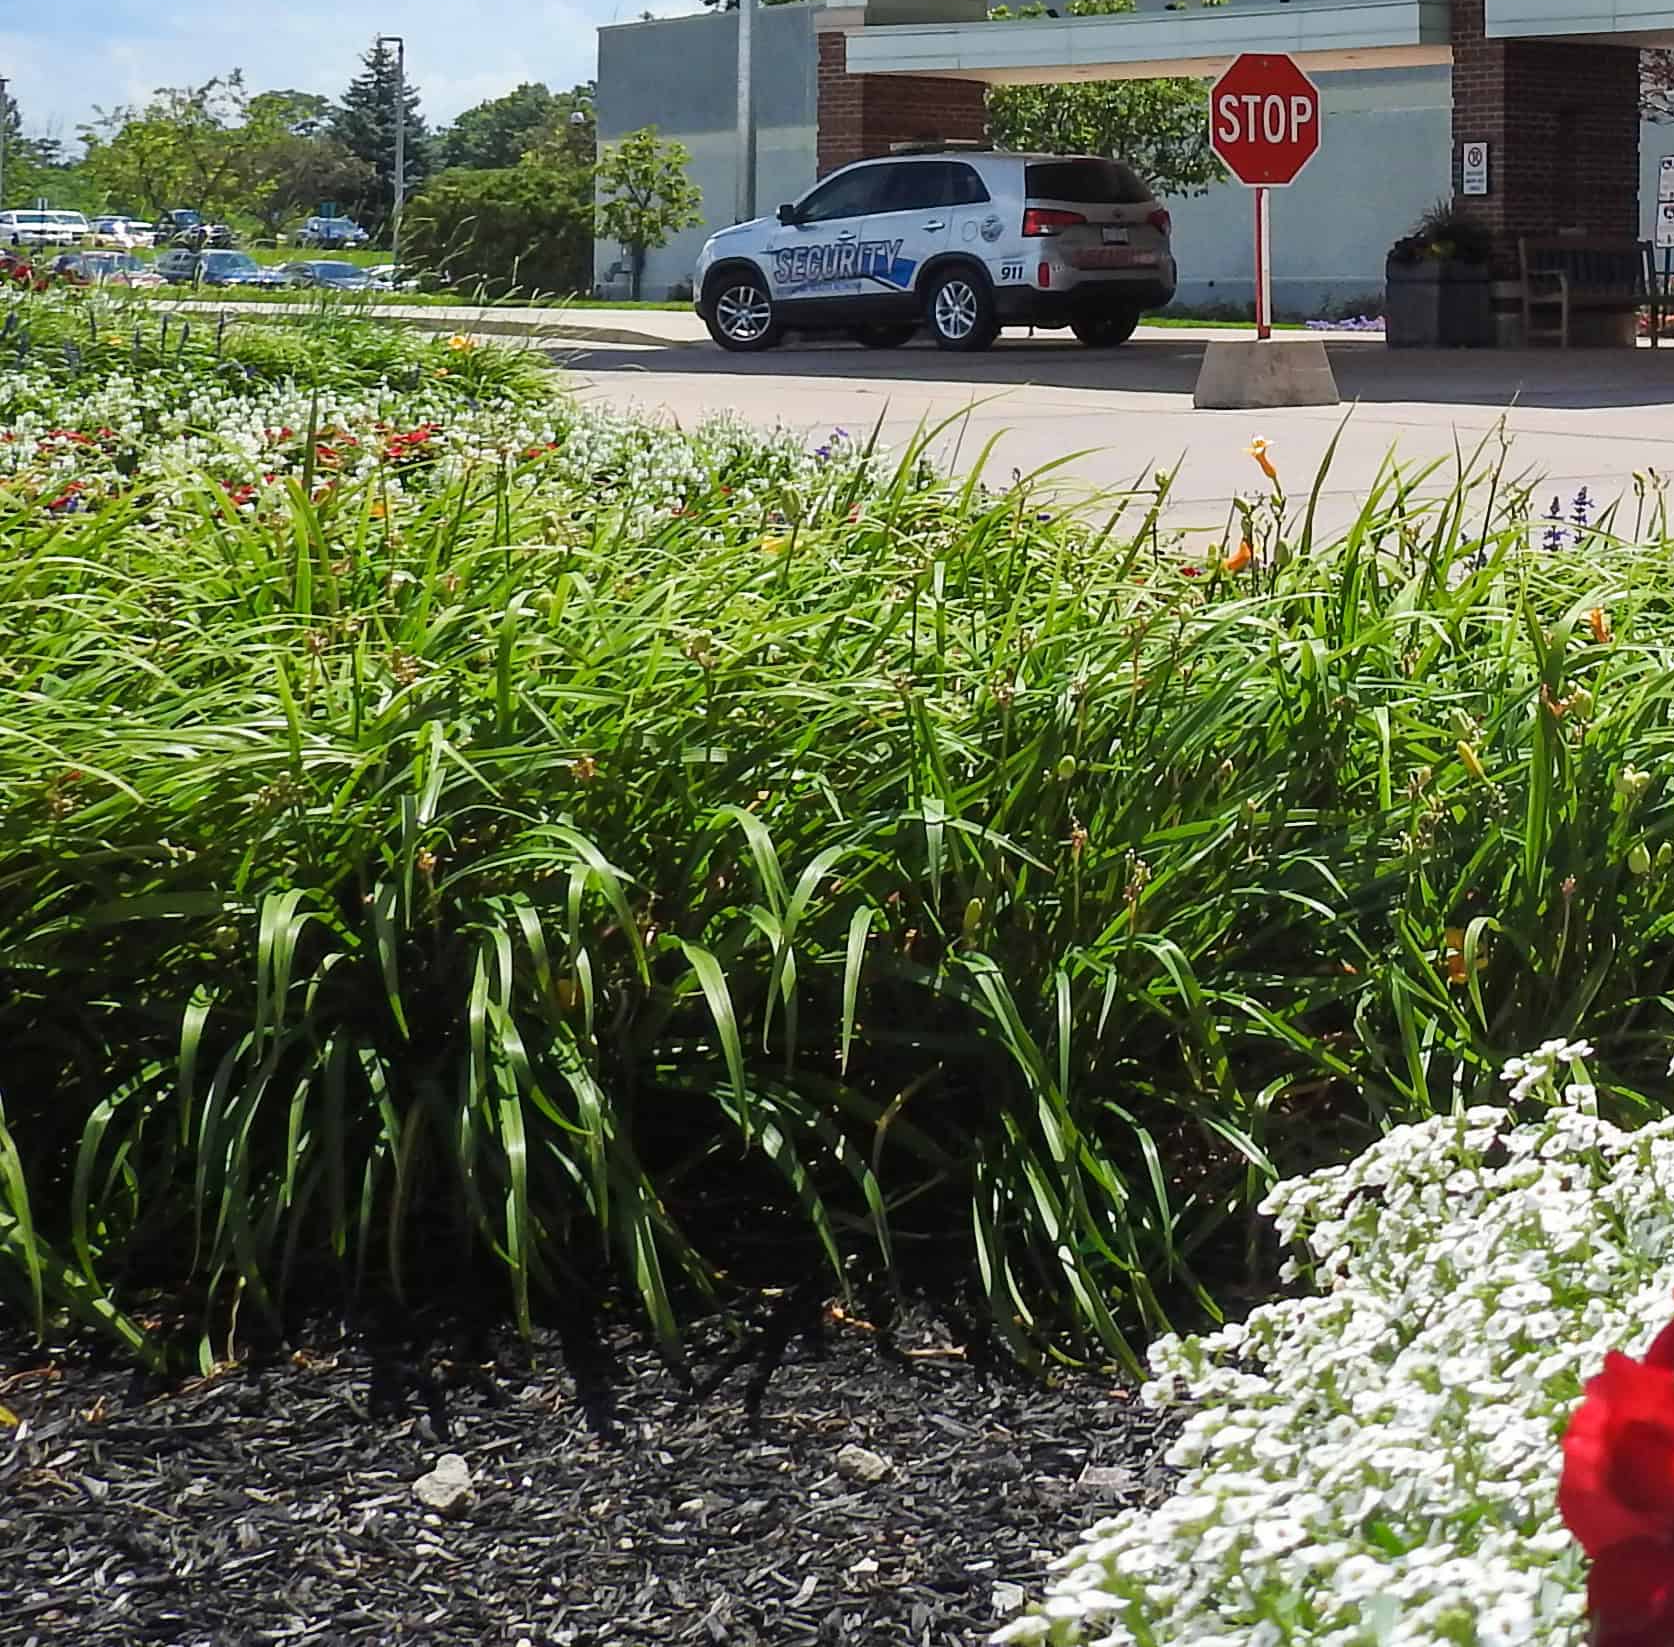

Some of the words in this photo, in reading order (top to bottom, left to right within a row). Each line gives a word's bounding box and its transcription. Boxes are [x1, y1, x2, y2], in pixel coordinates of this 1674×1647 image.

[1218, 94, 1312, 143] STOP
[774, 239, 904, 284] SECURITY
[1000, 264, 1024, 281] 911
